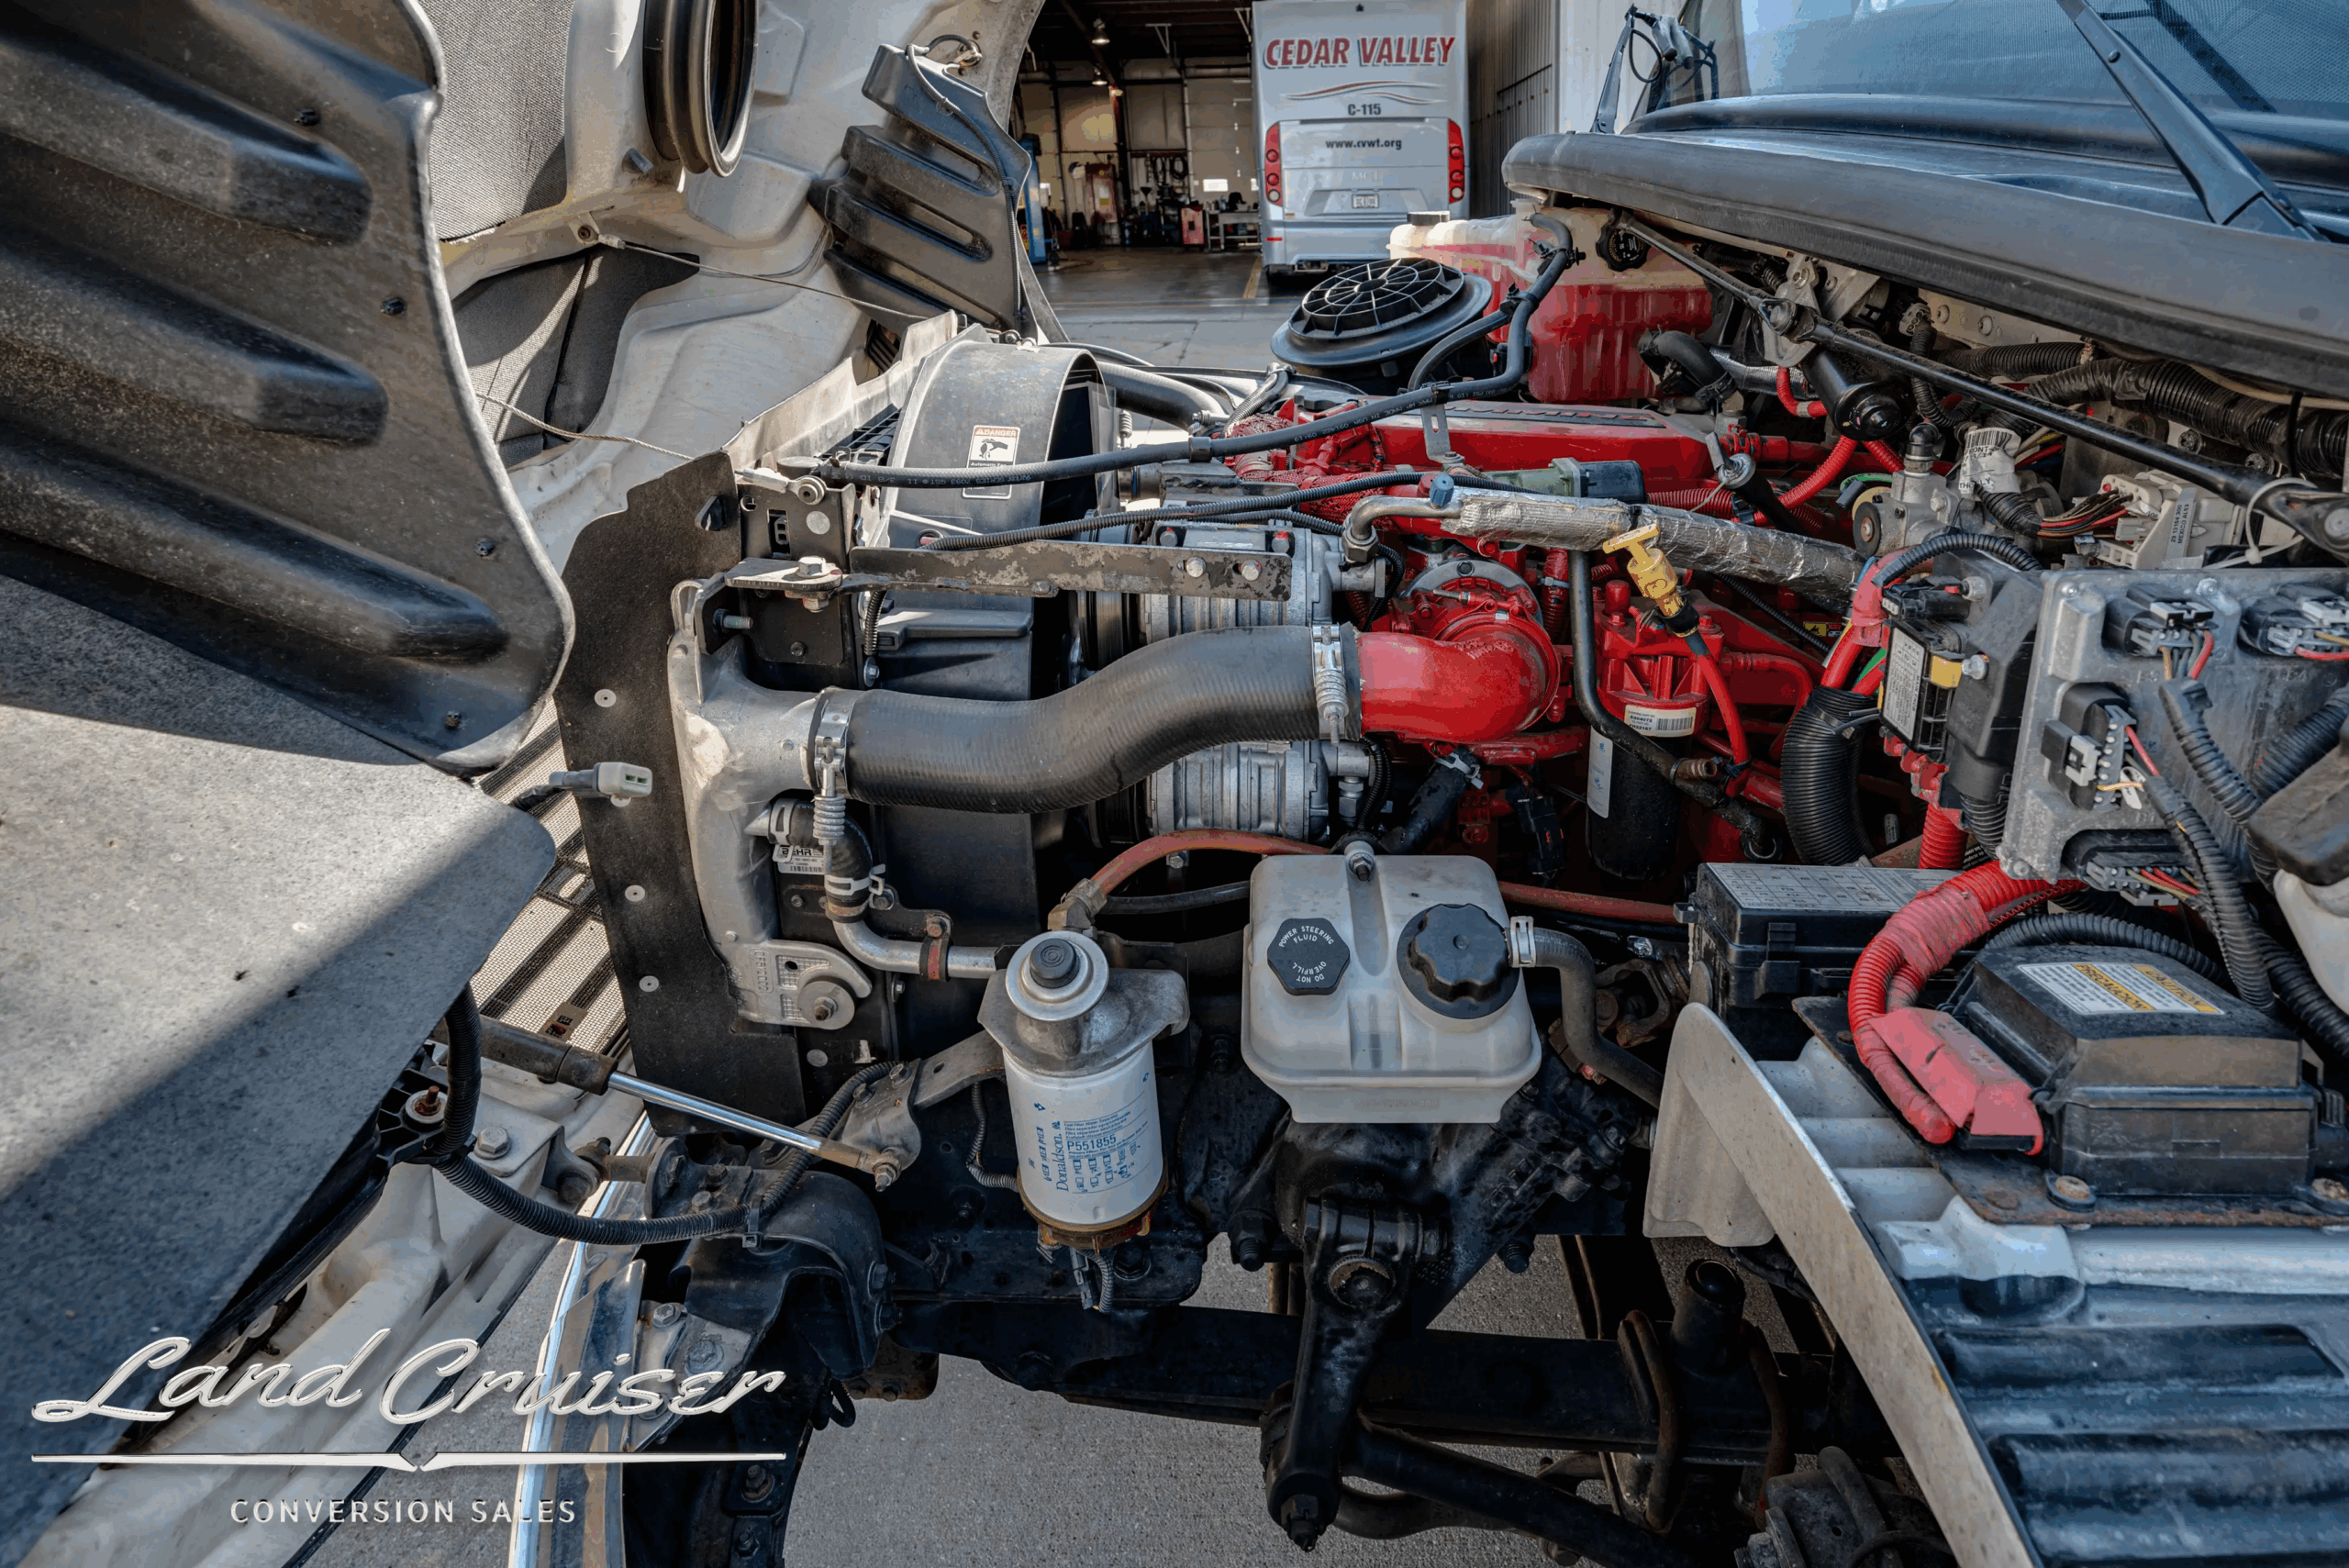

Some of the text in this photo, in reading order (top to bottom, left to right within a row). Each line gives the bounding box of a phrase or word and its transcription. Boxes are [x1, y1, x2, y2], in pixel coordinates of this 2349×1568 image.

[1264, 37, 1455, 69] CEDAR VALLEY
[1347, 104, 1382, 116] C-115
[1325, 138, 1402, 150] www.cvwt.org
[1418, 397, 1433, 406] MAX
[1384, 406, 1403, 417] MADE
[1353, 417, 1368, 425] USA
[984, 428, 1017, 437] DANGER
[976, 476, 1005, 484] SERIES
[2177, 520, 2187, 544] MEXICO
[1278, 926, 1334, 948] POWER STEERING
[1293, 934, 1318, 944] FLUID
[1292, 961, 1327, 975] OVERFILL
[1296, 973, 1325, 984] DO NOT
[1067, 1134, 1116, 1151] P551855
